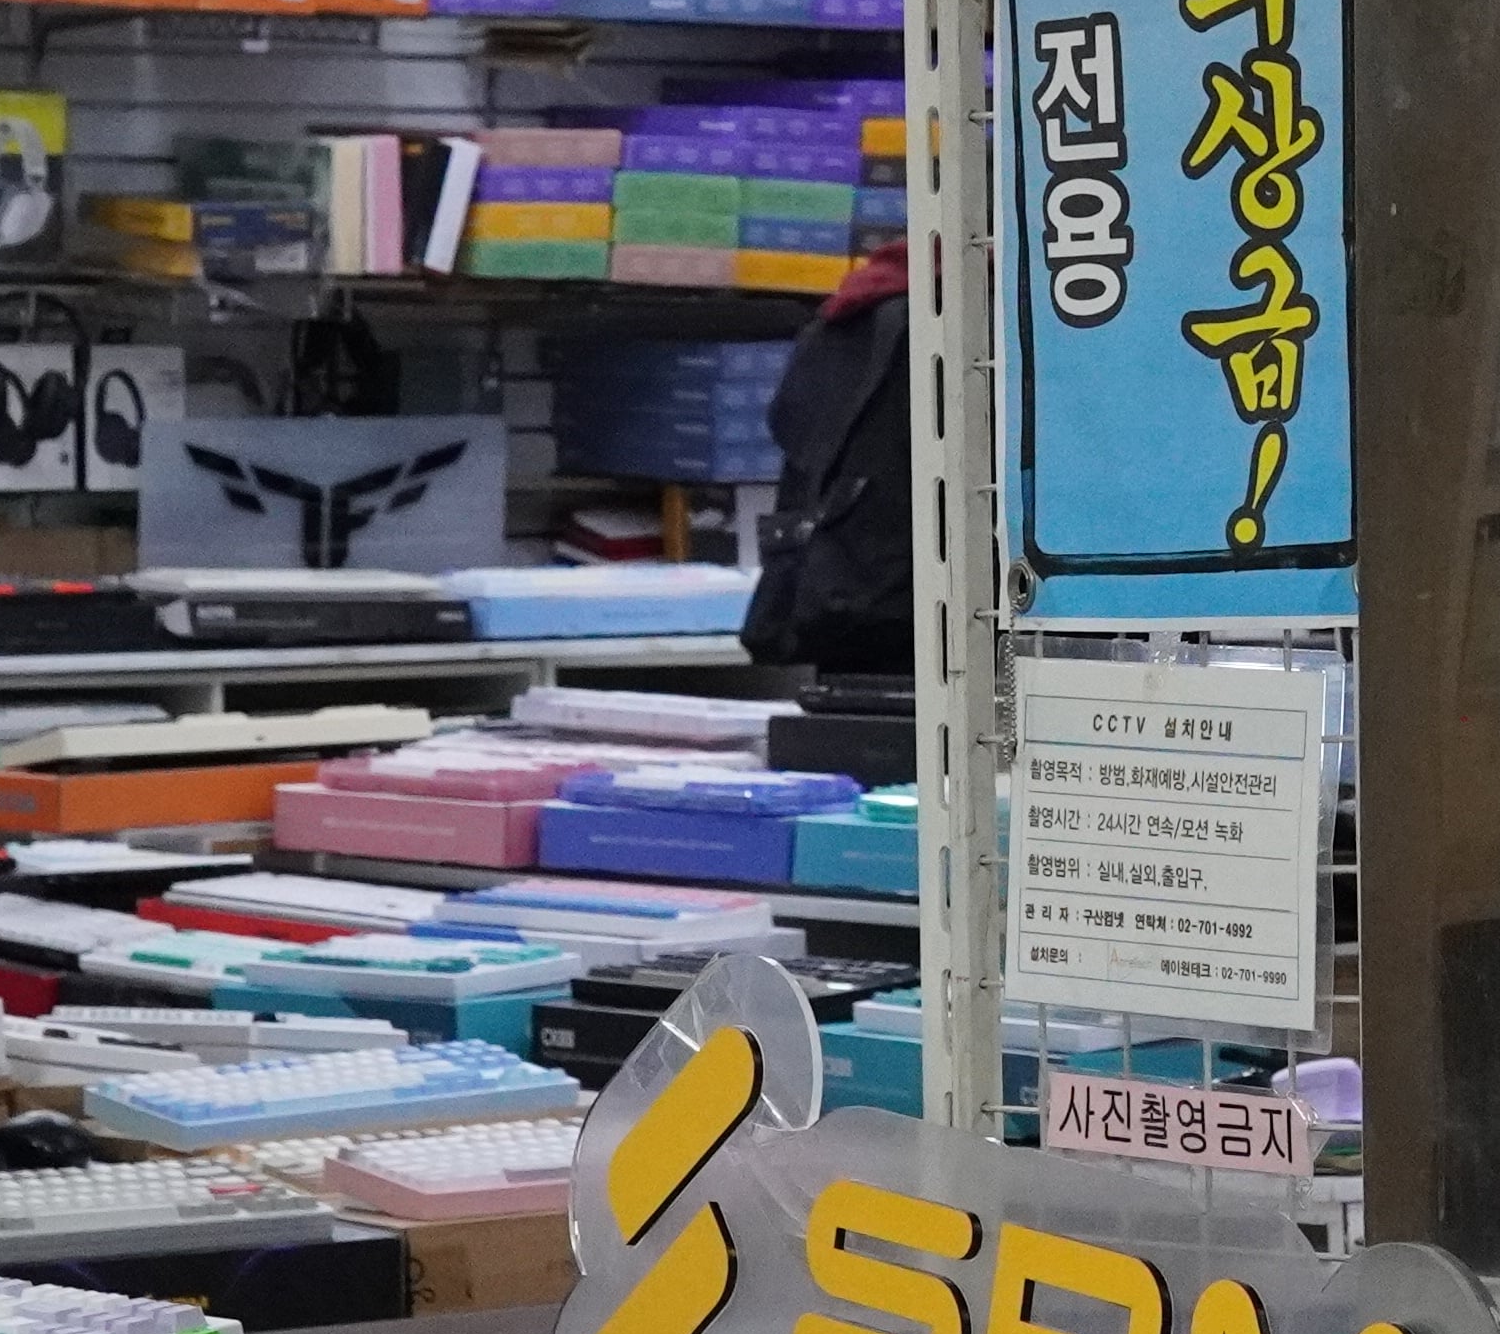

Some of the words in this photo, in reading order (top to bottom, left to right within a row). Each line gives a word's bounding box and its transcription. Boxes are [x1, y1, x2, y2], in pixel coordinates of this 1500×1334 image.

[1034, 12, 1135, 330] 전용
[1092, 713, 1147, 736] CCTV
[1163, 717, 1233, 742] 설치안내
[1029, 757, 1084, 783] 촬영목적
[1028, 805, 1084, 832] 촬영시간
[1097, 810, 1142, 833] 24시간
[1146, 815, 1210, 843] 연속/모션
[1214, 819, 1245, 843] 녹화
[1027, 853, 1082, 880] 촬영범위
[1177, 918, 1254, 940] 02-701-4992
[1220, 966, 1288, 987] 02-701-9990
[1056, 1082, 1298, 1167] 사진촬영금지
